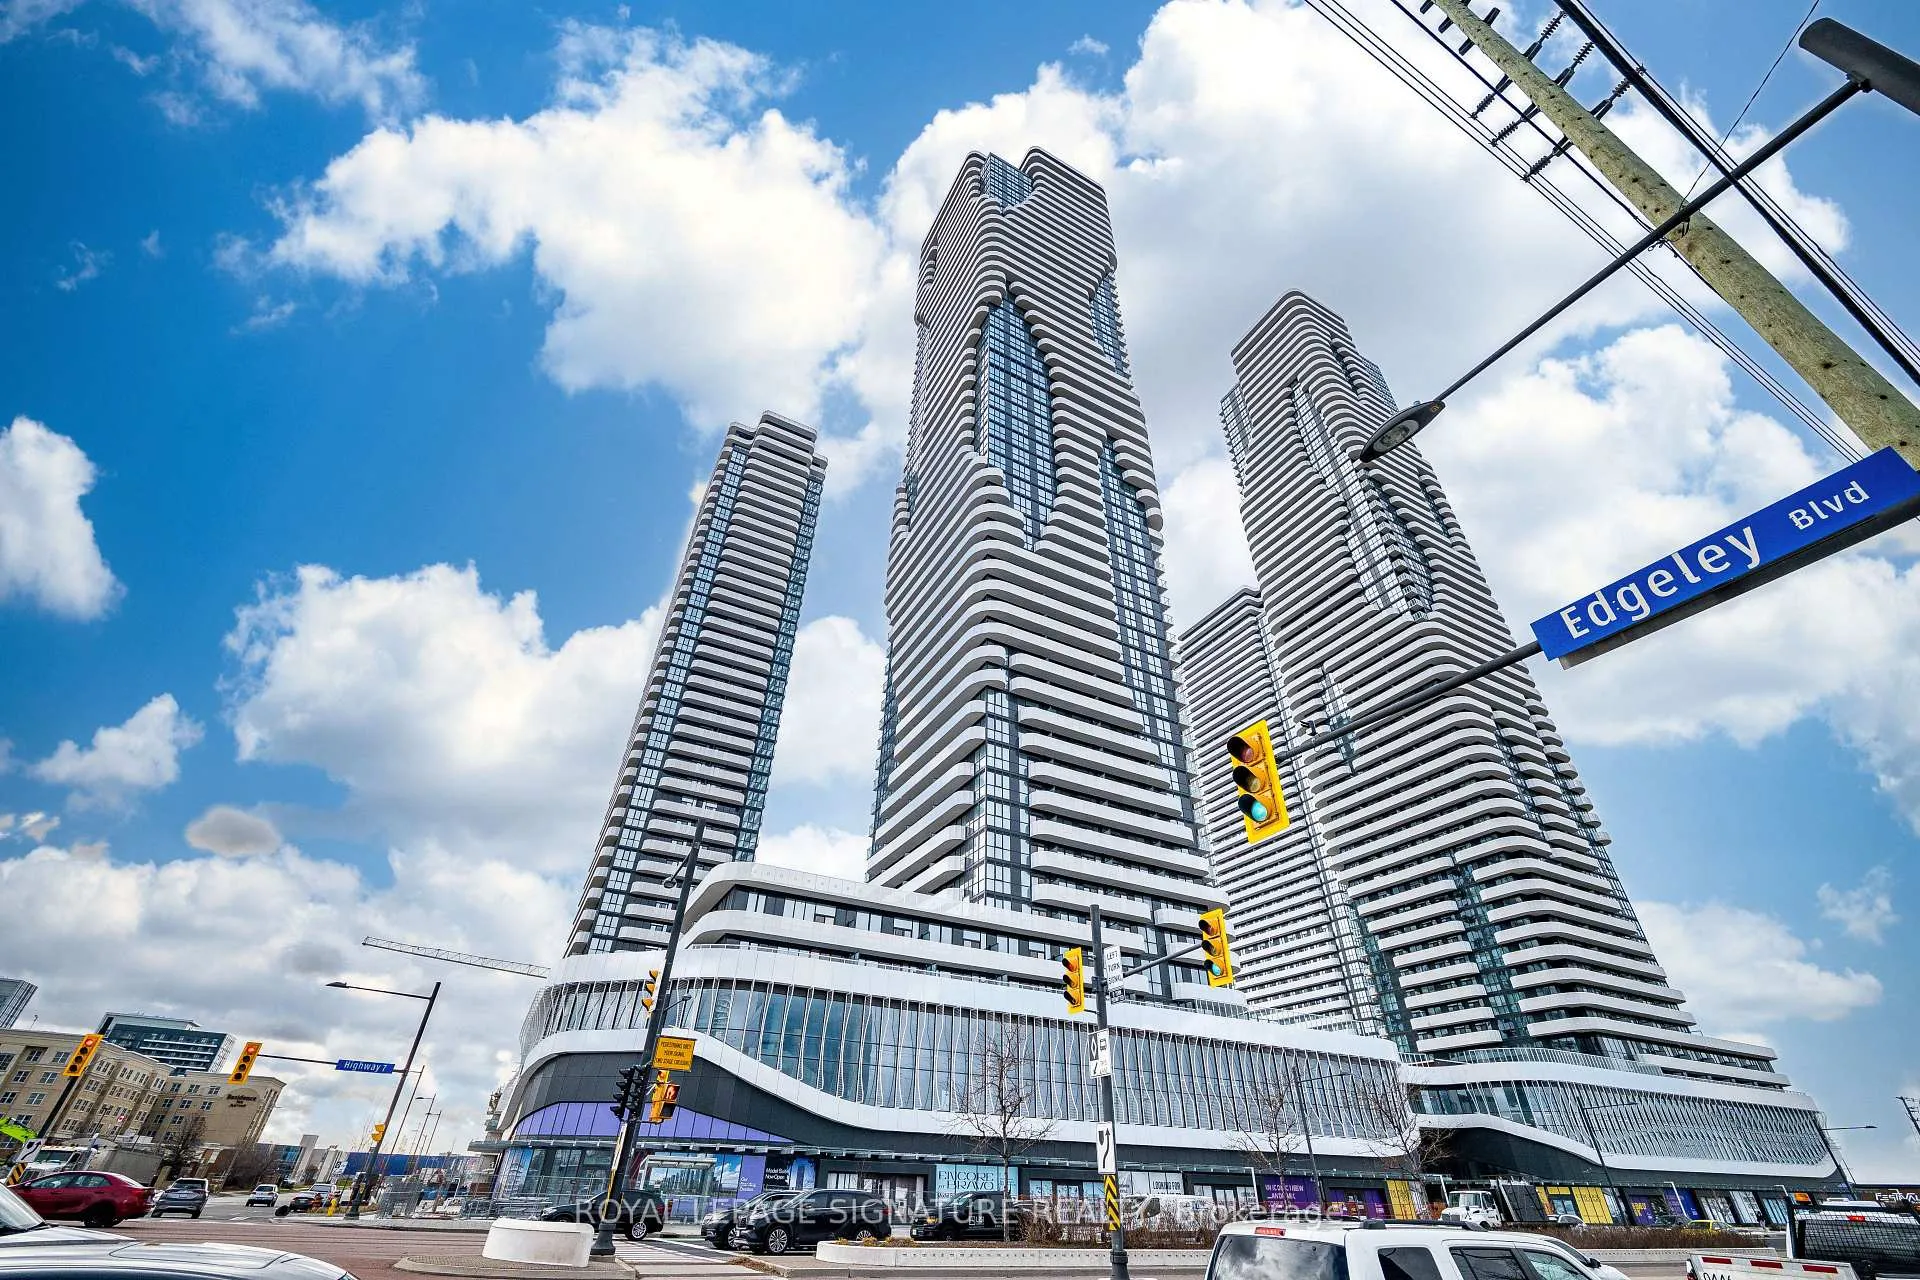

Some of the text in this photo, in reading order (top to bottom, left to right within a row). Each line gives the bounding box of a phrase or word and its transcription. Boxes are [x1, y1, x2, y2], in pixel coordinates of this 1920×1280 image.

[1559, 480, 1871, 640] Edgeley Blvd
[1106, 950, 1118, 961] LEFT
[344, 1061, 388, 1072] Highway 7
